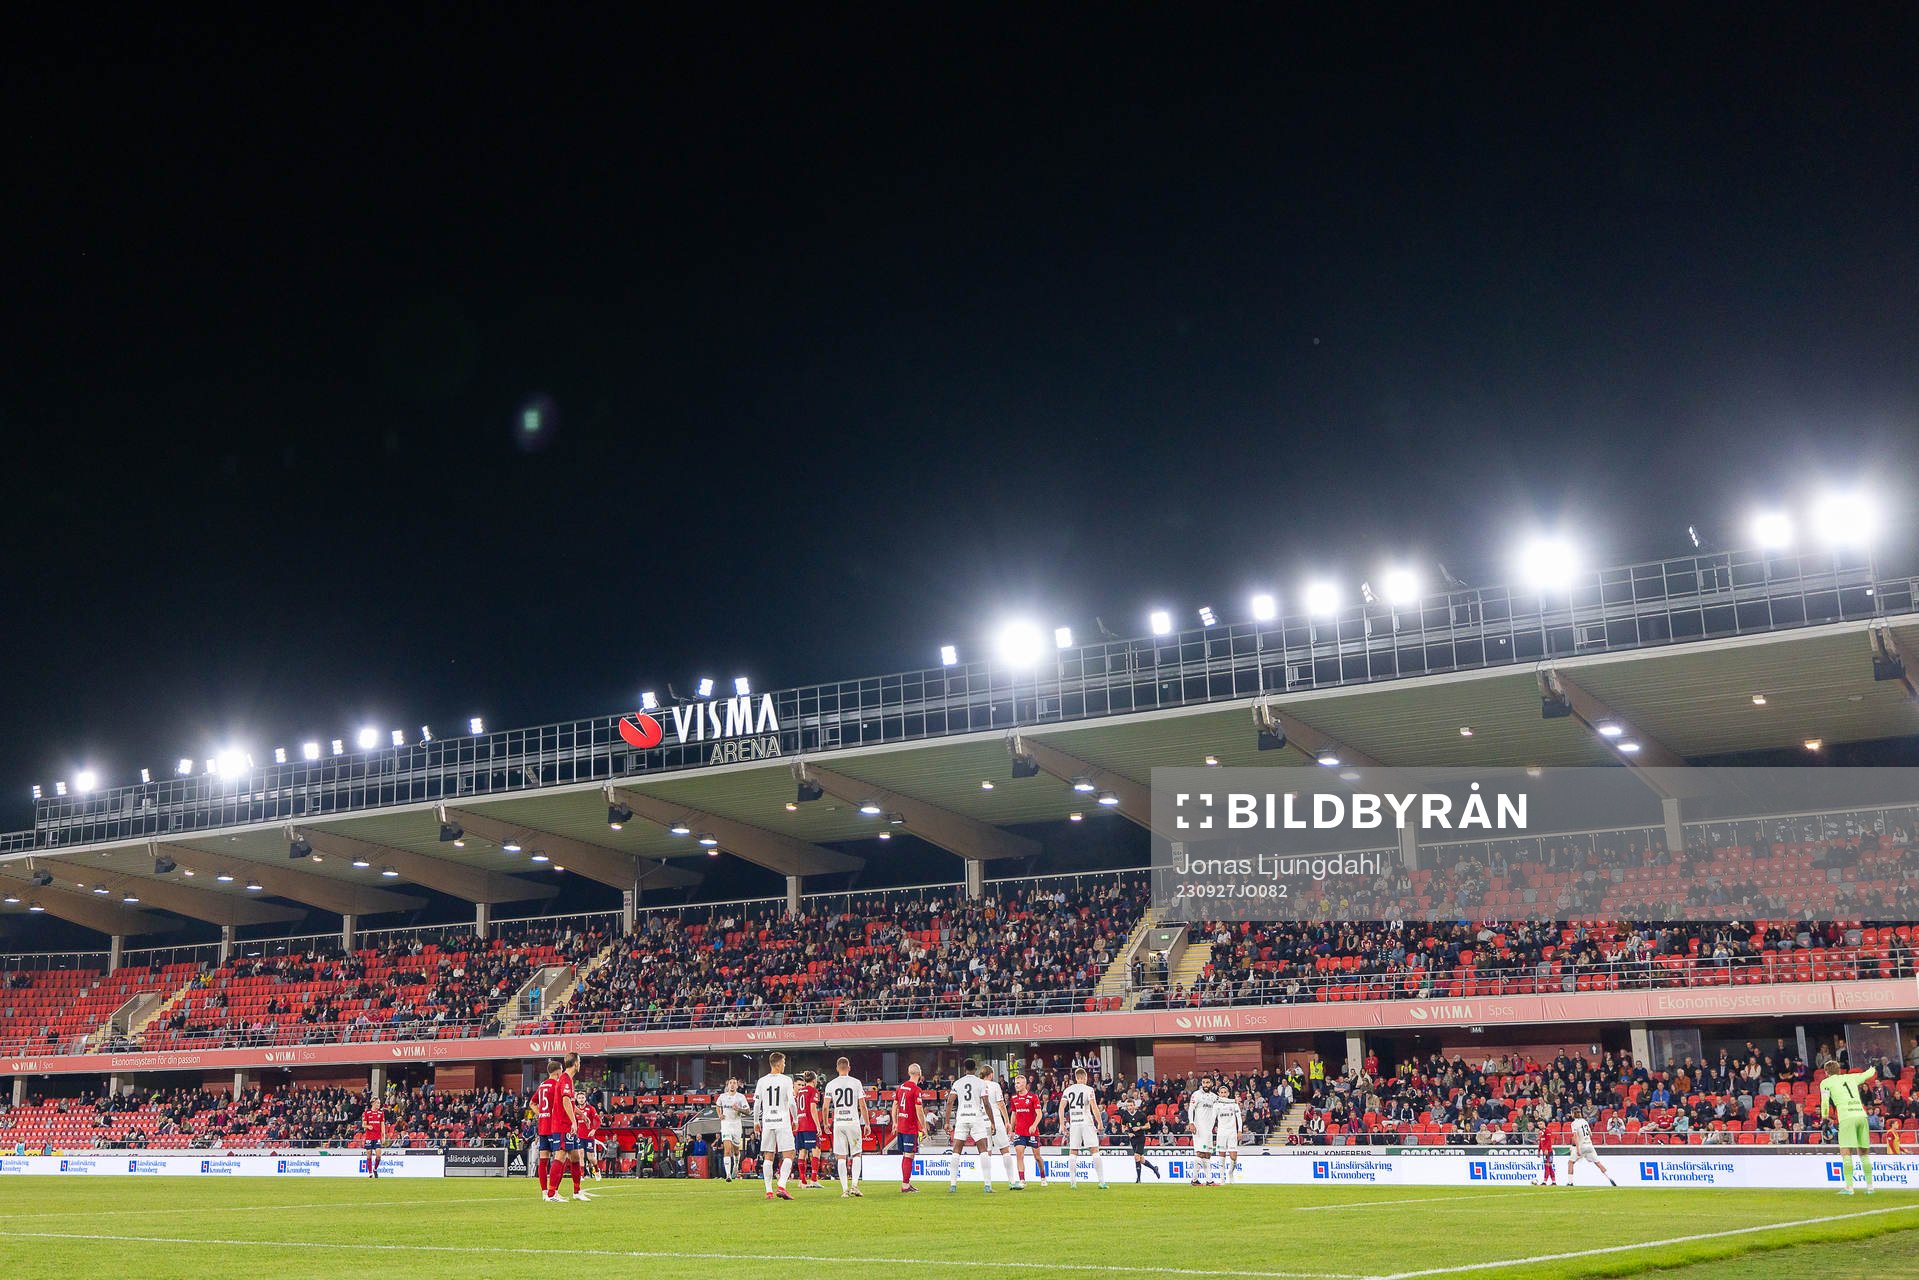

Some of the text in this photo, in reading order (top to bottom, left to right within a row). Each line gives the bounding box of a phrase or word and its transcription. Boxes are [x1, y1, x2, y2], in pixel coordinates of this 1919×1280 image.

[672, 693, 779, 743] VISMA
[710, 736, 781, 765] ARENA
[1658, 988, 1895, 1010] Ekonomisystem för din passion
[1431, 1004, 1514, 1020] VISMA Spcs
[1194, 1014, 1268, 1028] VISMA Spcs
[756, 1031, 777, 1040] VISMA
[988, 1022, 1053, 1036] VISMA Spcs
[403, 1045, 448, 1057] VISMA Spcs
[542, 1040, 591, 1052] VISMA Spcs
[111, 1057, 156, 1068] Ekonomisystem
[275, 1051, 295, 1061] VISMA
[766, 1085, 780, 1106] 11
[964, 1083, 972, 1101] 3
[1842, 1081, 1855, 1098] 1
[538, 1088, 549, 1111] 15
[834, 1087, 854, 1107] 20
[900, 1092, 906, 1111] 4
[1068, 1091, 1084, 1109] 24
[1581, 1124, 1591, 1137] 13
[925, 1160, 974, 1168] Länsförring
[1330, 1161, 1393, 1171] Länsförsäkring
[1660, 1161, 1734, 1173] Länsförsäkring
[1330, 1171, 1376, 1181] Kronoberg
[1661, 1172, 1714, 1183] Kronoberg
